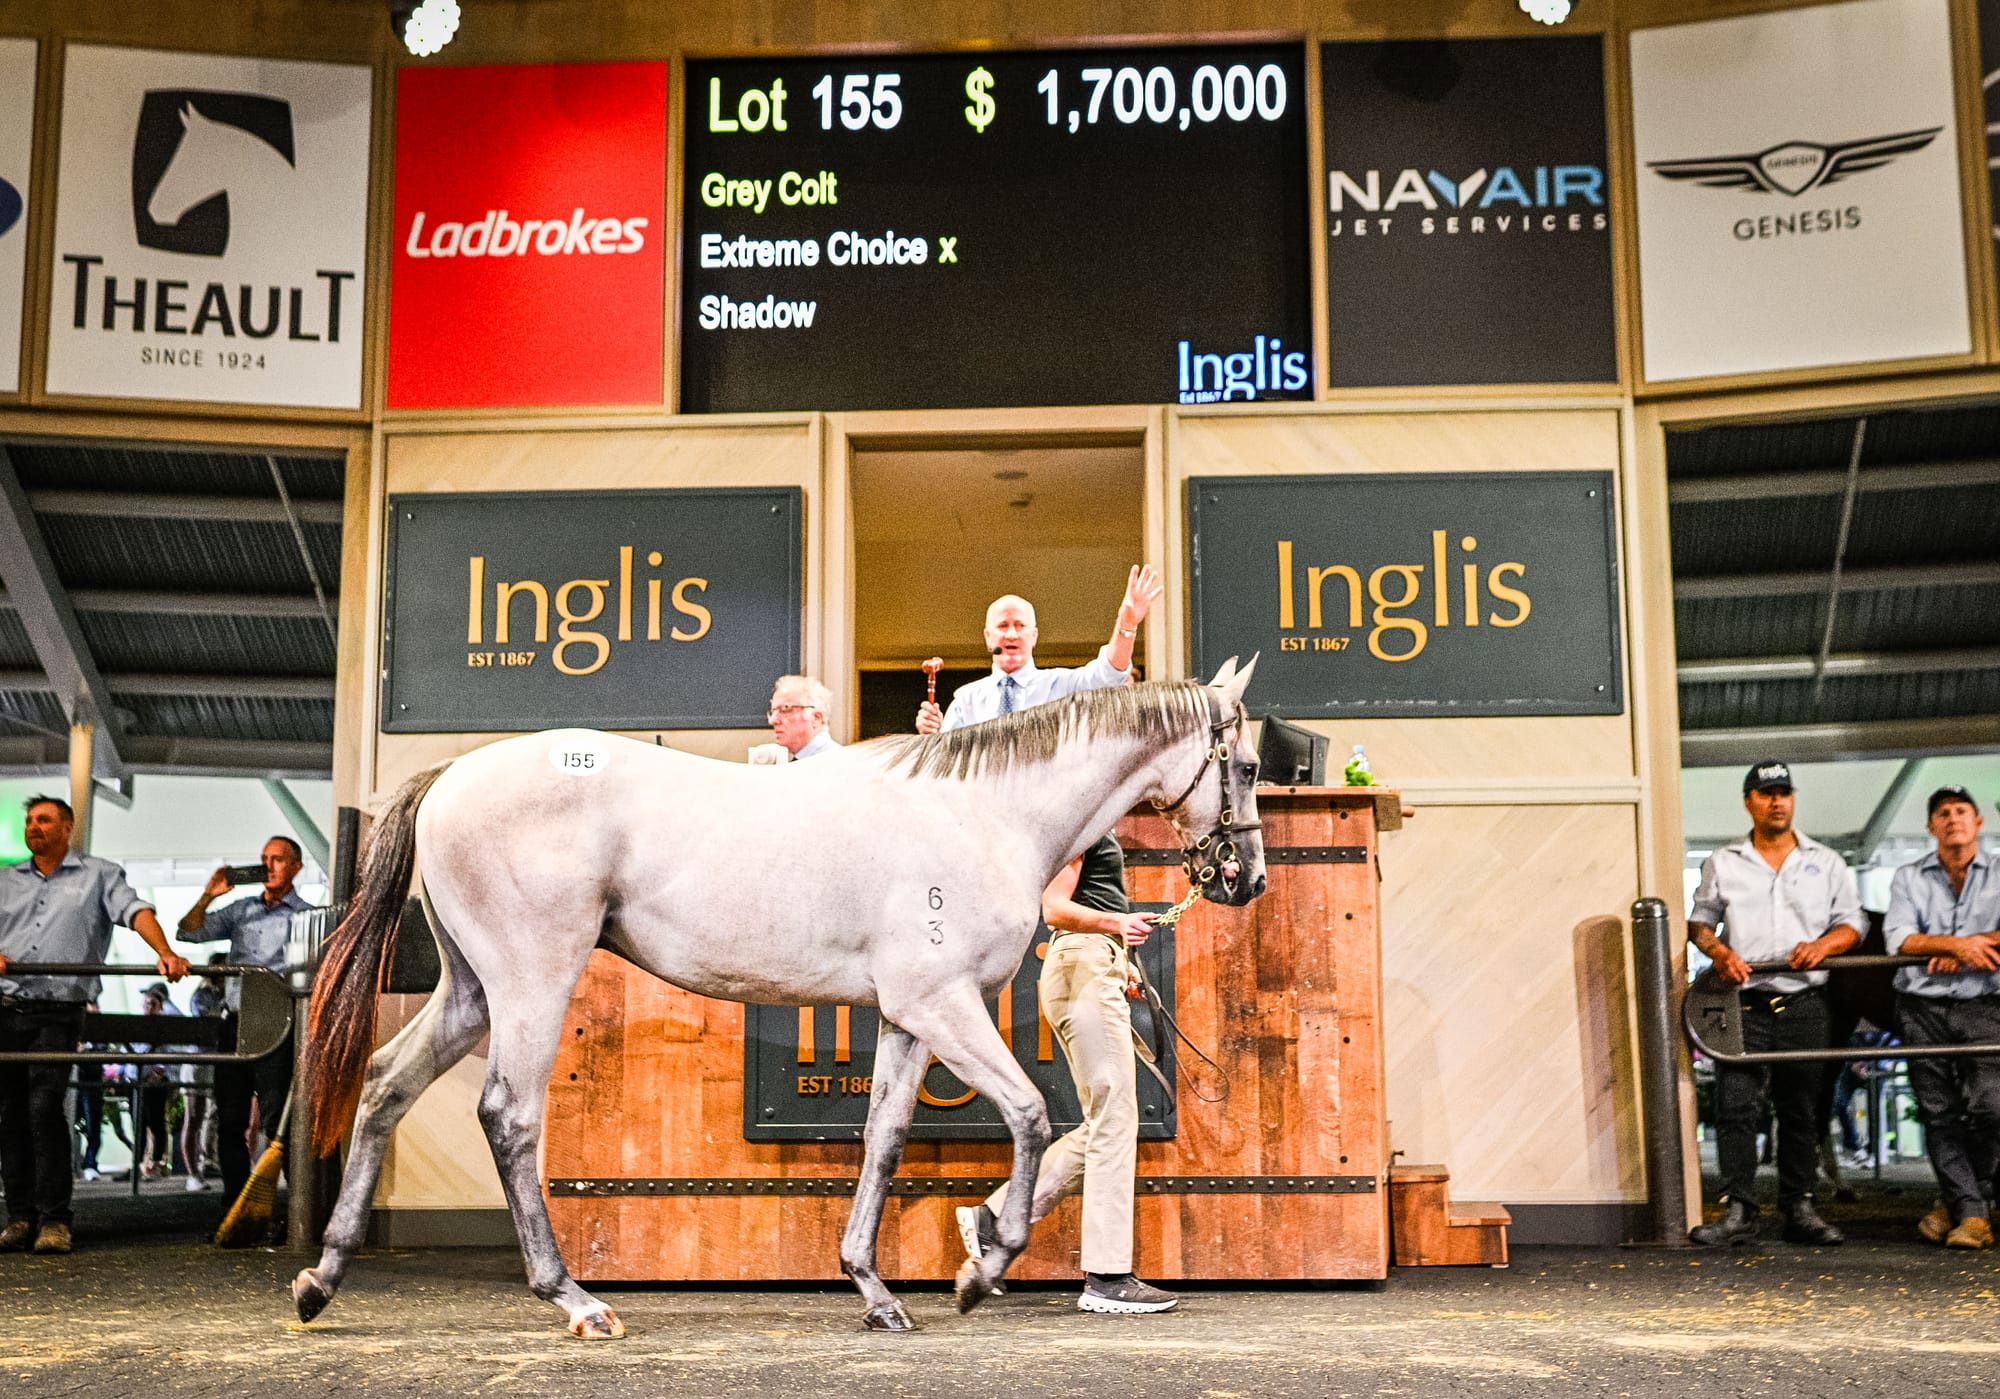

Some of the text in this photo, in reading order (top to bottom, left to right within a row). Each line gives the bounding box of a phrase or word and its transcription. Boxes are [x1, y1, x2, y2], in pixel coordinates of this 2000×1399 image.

[709, 63, 1287, 134] Lot 155 $ 1,700,000
[700, 170, 838, 214] Grey Colt
[1329, 165, 1603, 212] NAVAIR
[406, 207, 649, 258] Ladbrokes
[1330, 213, 1607, 237] JET SERVICES
[1732, 206, 1862, 241] GENESIS
[700, 230, 958, 269] Extreme Choice x
[62, 253, 355, 343] THEAULT
[698, 294, 817, 330] Shadow
[141, 347, 266, 370] SINCE 1924
[1177, 335, 1308, 401] Inglis
[467, 545, 712, 675] Inglis
[1277, 529, 1532, 662] Inglis
[467, 651, 536, 667] EST 1867
[1280, 637, 1350, 652] EST 1867
[562, 752, 595, 769] 155
[928, 886, 944, 911] 6
[928, 920, 944, 946] 3
[797, 1075, 873, 1094] EST 186
